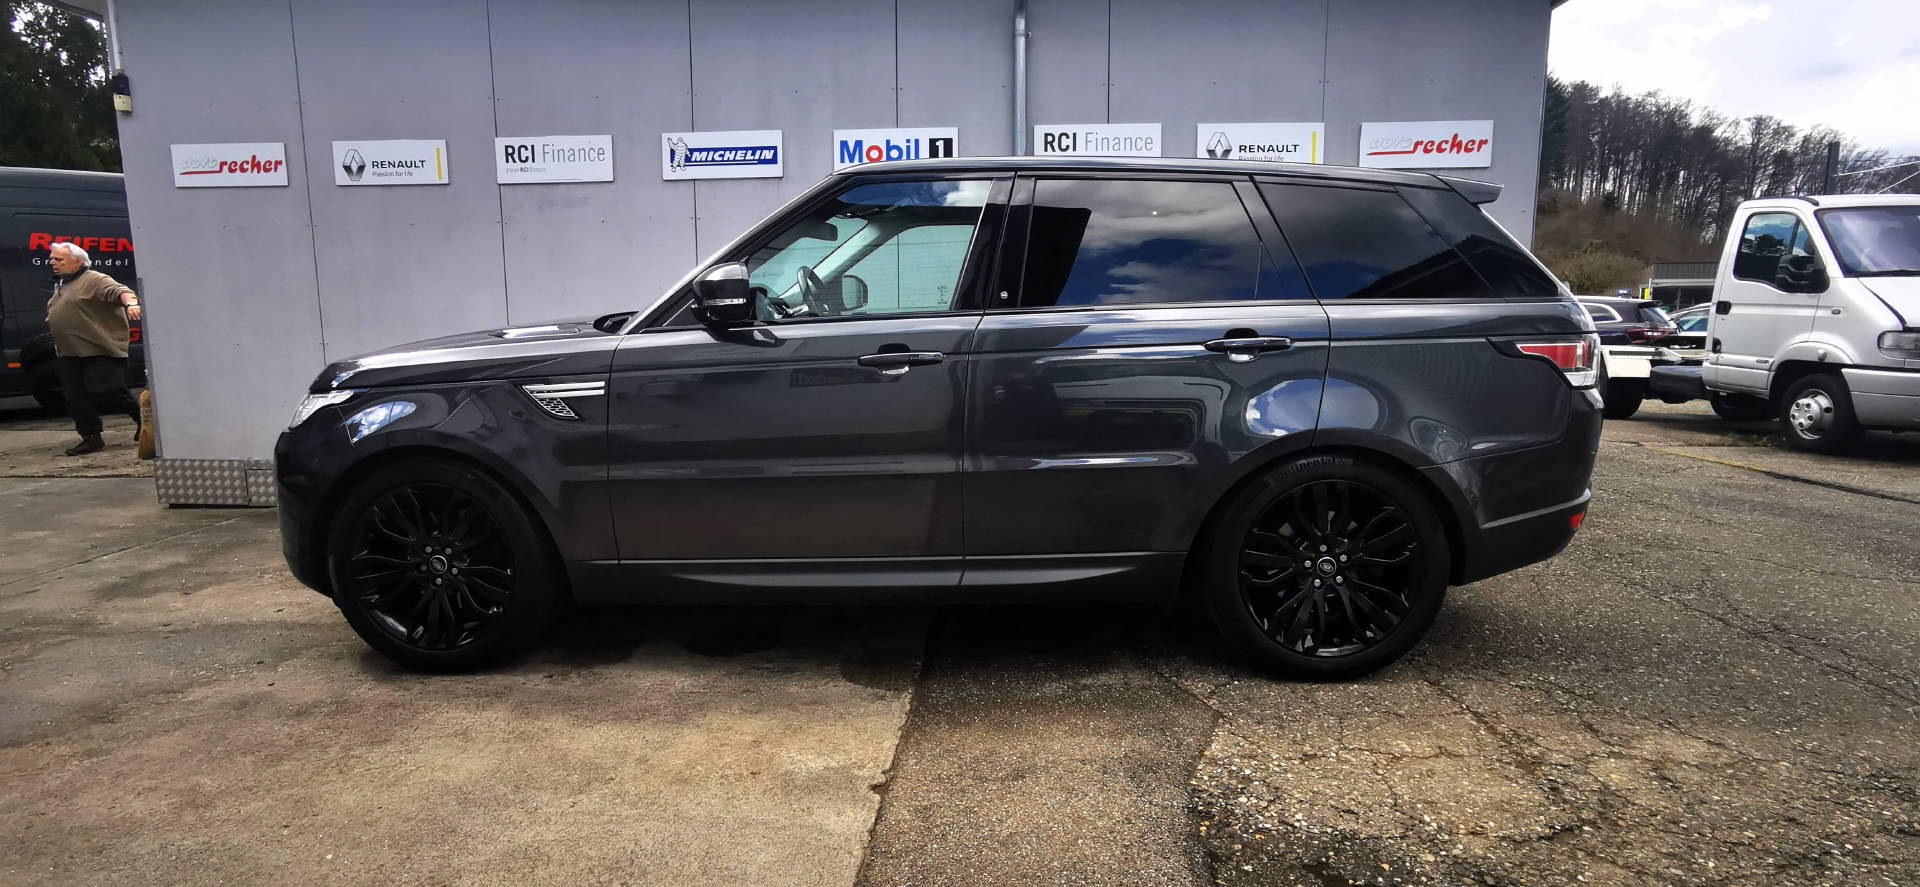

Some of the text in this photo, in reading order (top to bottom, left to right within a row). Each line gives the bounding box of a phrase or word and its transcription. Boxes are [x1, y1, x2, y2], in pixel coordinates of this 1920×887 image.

[840, 139, 920, 164] Mobil
[1043, 131, 1154, 152] RCI Finance
[1238, 144, 1300, 153] RENAULT
[1411, 133, 1489, 154] recher
[504, 143, 606, 163] RCI Finance
[690, 149, 775, 162] MICHELIN
[218, 154, 283, 174] recher
[371, 159, 426, 168] RENAULT
